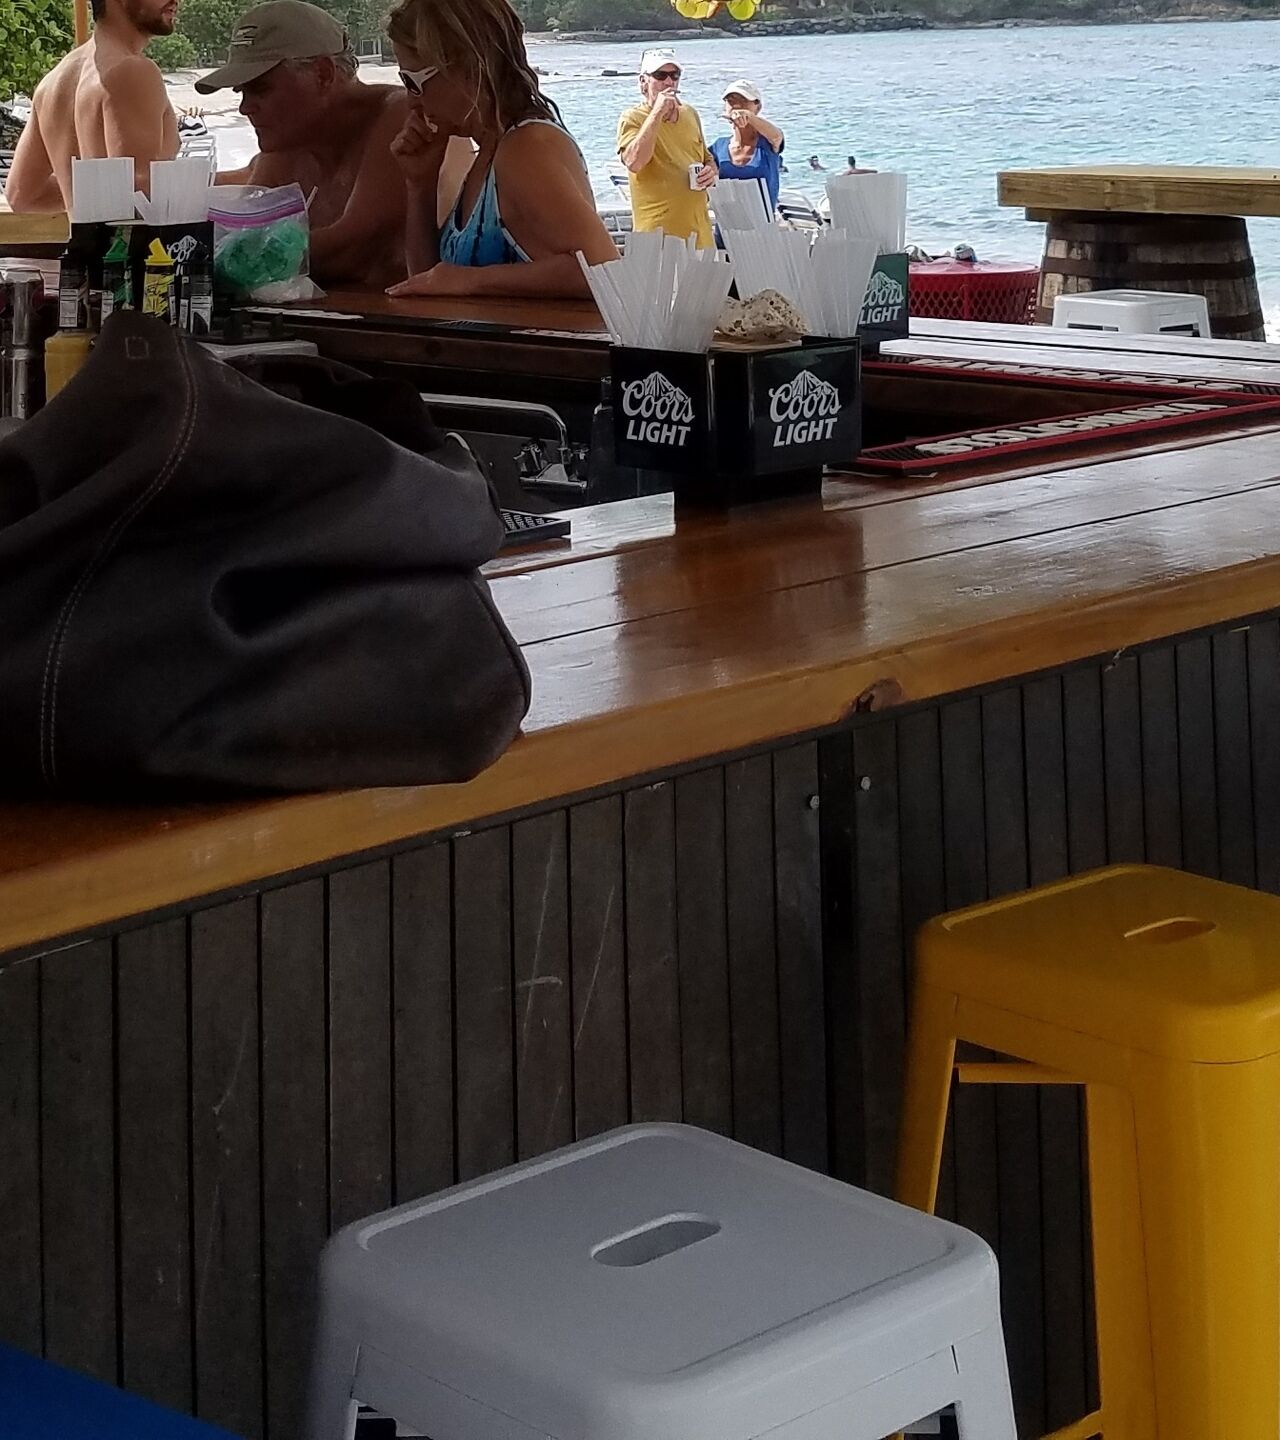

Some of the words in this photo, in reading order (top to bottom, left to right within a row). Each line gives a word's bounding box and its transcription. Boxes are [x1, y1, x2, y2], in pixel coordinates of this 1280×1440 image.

[858, 305, 902, 325] LIGHT
[621, 377, 696, 423] Coors
[769, 377, 842, 423] Coors
[626, 419, 691, 447] LIGHT
[773, 417, 838, 448] LIGHT
